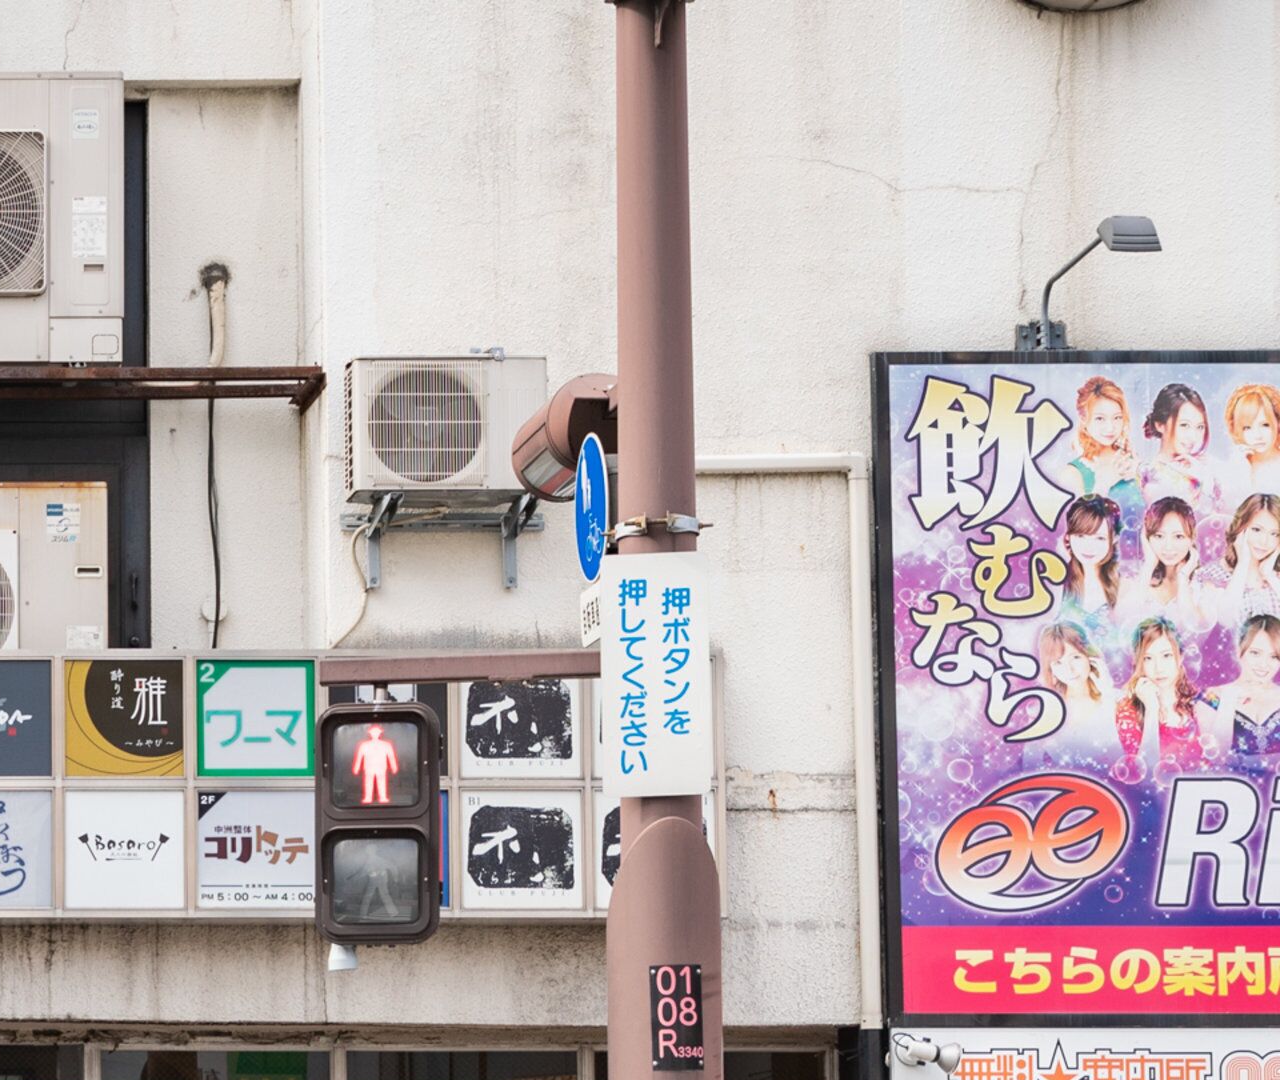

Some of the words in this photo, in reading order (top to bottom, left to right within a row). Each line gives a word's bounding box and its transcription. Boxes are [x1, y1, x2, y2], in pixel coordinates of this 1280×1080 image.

[908, 374, 1075, 744] 飲むなら
[200, 663, 215, 682] 2
[618, 579, 648, 775] 押してください
[661, 587, 691, 735] 押ボタンを
[131, 676, 168, 726] 雅
[200, 796, 216, 805] 2F
[656, 965, 692, 996] 01
[657, 997, 698, 1027] 08
